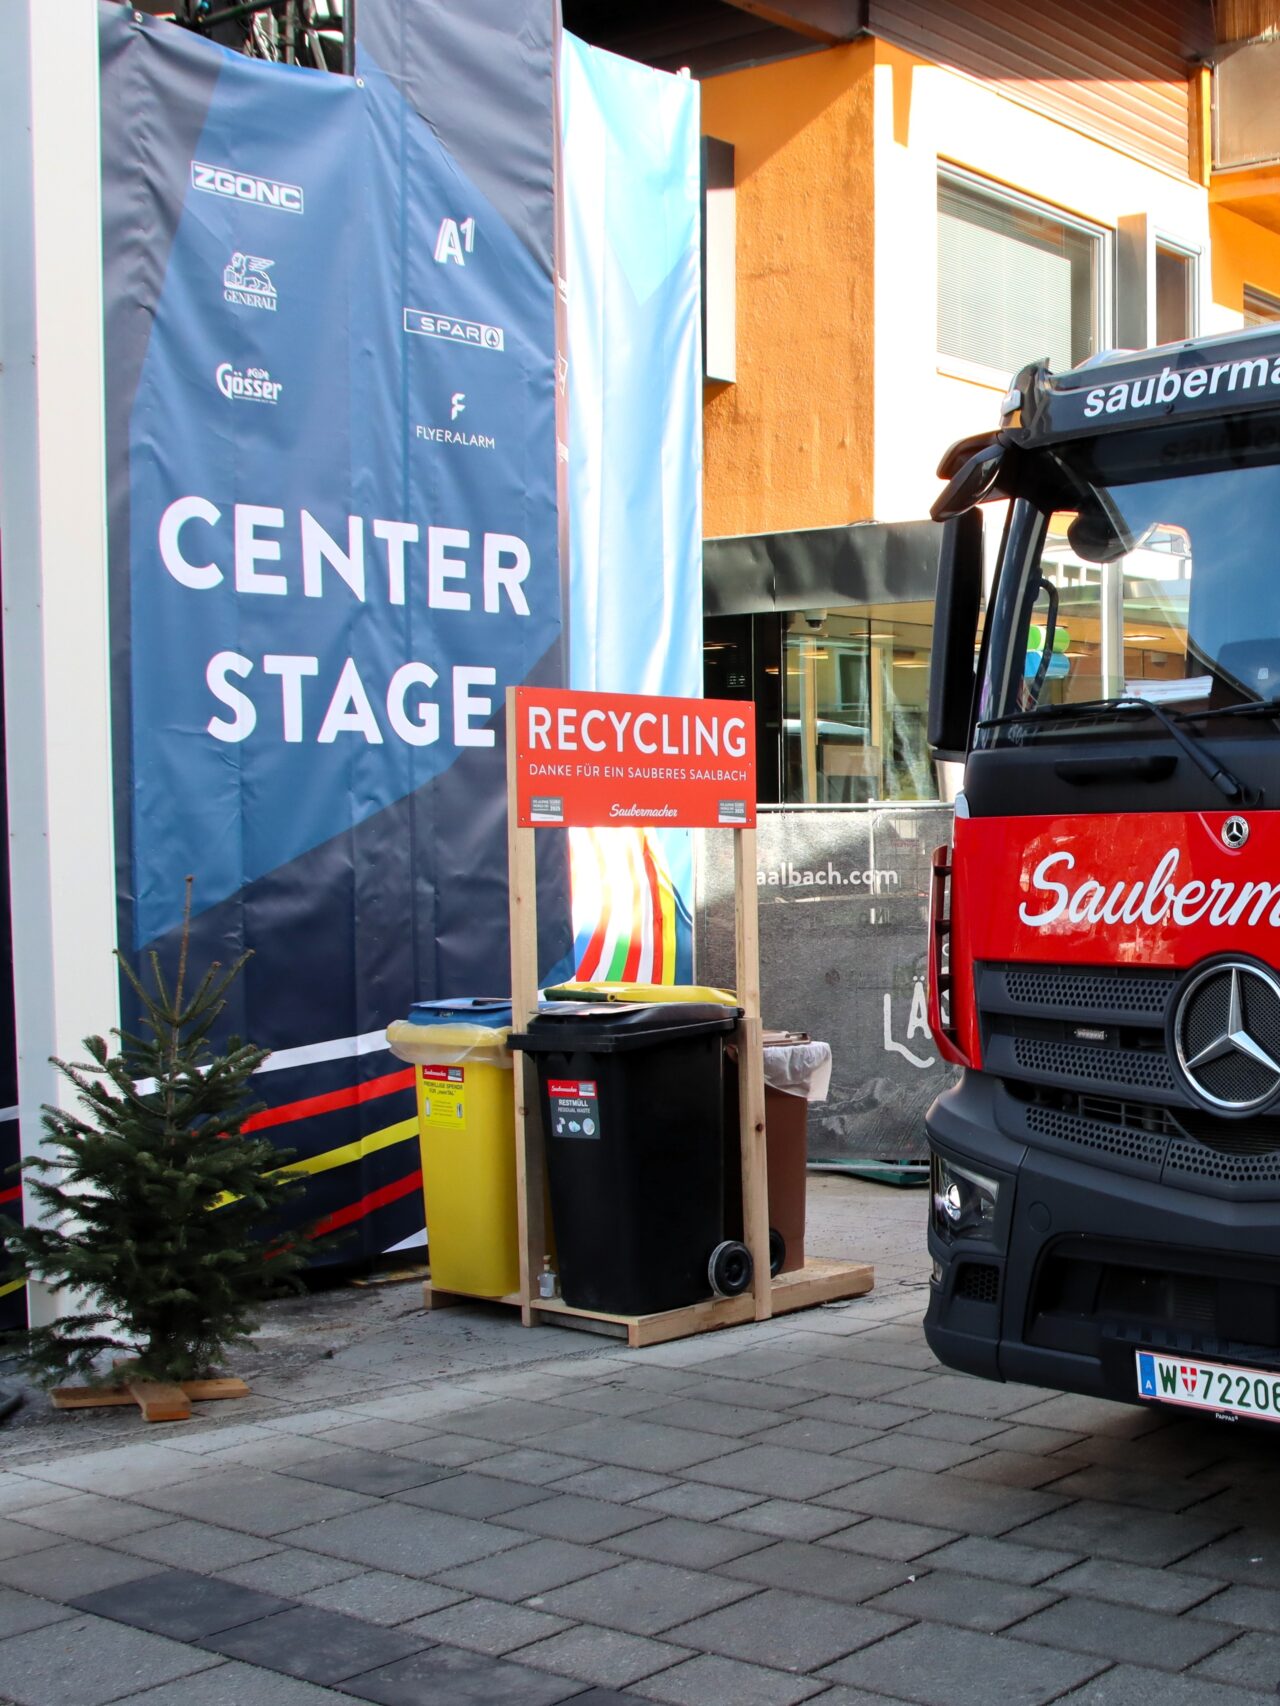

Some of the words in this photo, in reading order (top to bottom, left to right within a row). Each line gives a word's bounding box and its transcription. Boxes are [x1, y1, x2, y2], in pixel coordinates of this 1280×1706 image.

[194, 165, 301, 210] ZGONC
[434, 216, 475, 267] A1
[223, 289, 277, 312] GENERALI
[420, 316, 480, 342] SPAR
[216, 362, 283, 400] Gösser
[416, 425, 496, 449] FLYERALARM
[158, 495, 532, 616] CENTER
[205, 650, 497, 747] STAGE
[528, 706, 747, 758] RECYCLING
[529, 763, 572, 777] DANKE
[576, 763, 600, 777] FÜR
[604, 765, 624, 778] EIN
[628, 767, 686, 780] SAUBERES
[690, 769, 747, 781] SAALBACH
[609, 803, 678, 818] Saubermacher
[757, 862, 898, 885] aalbach.com
[558, 1098, 589, 1107] RESTMÜLL
[1145, 1379, 1153, 1390] A
